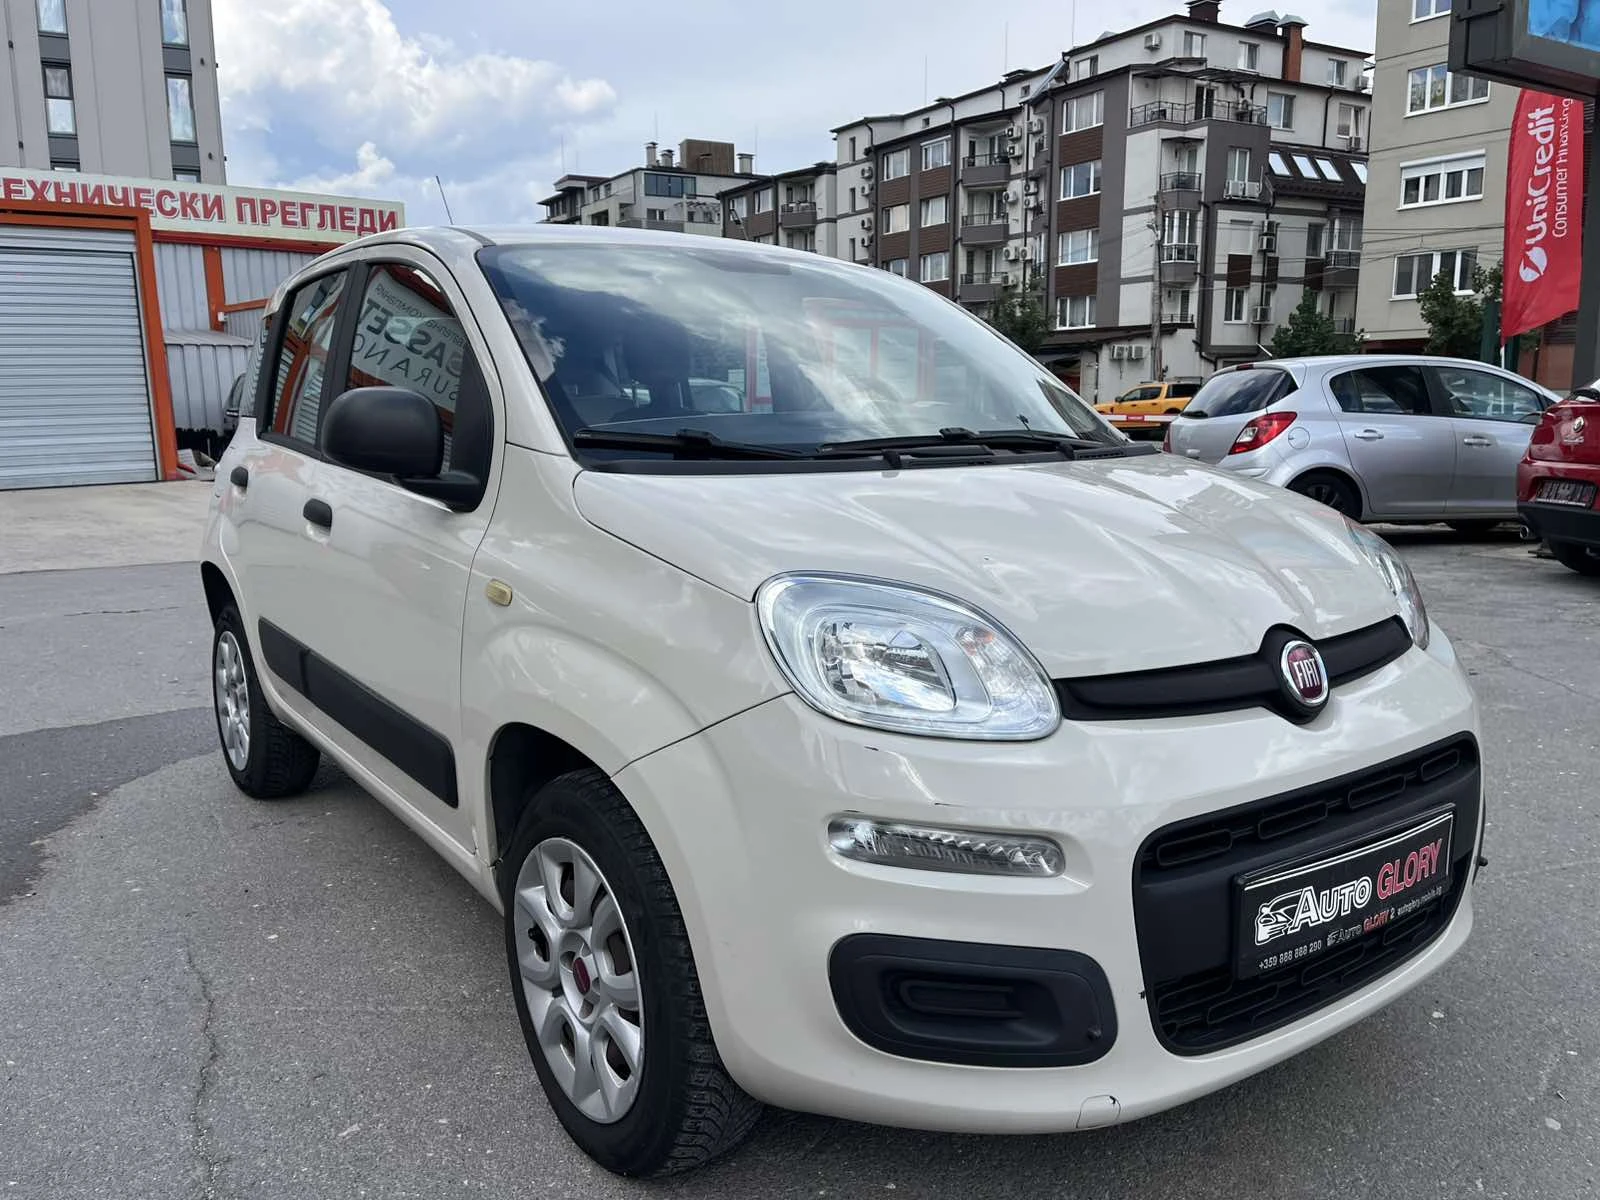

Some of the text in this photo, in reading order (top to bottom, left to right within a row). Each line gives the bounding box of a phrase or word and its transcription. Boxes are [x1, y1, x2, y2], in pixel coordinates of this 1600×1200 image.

[1525, 103, 1555, 246] UniCredit
[1552, 167, 1568, 238] Consumer
[0, 177, 398, 237] ЕХНИЧЕСКИ ПРЕГЛЕДИ
[1292, 658, 1320, 689] FIAT
[1377, 838, 1443, 900] GLORY
[1258, 956, 1278, 970] +359
[1279, 949, 1293, 963] 888
[1309, 939, 1322, 953] 290
